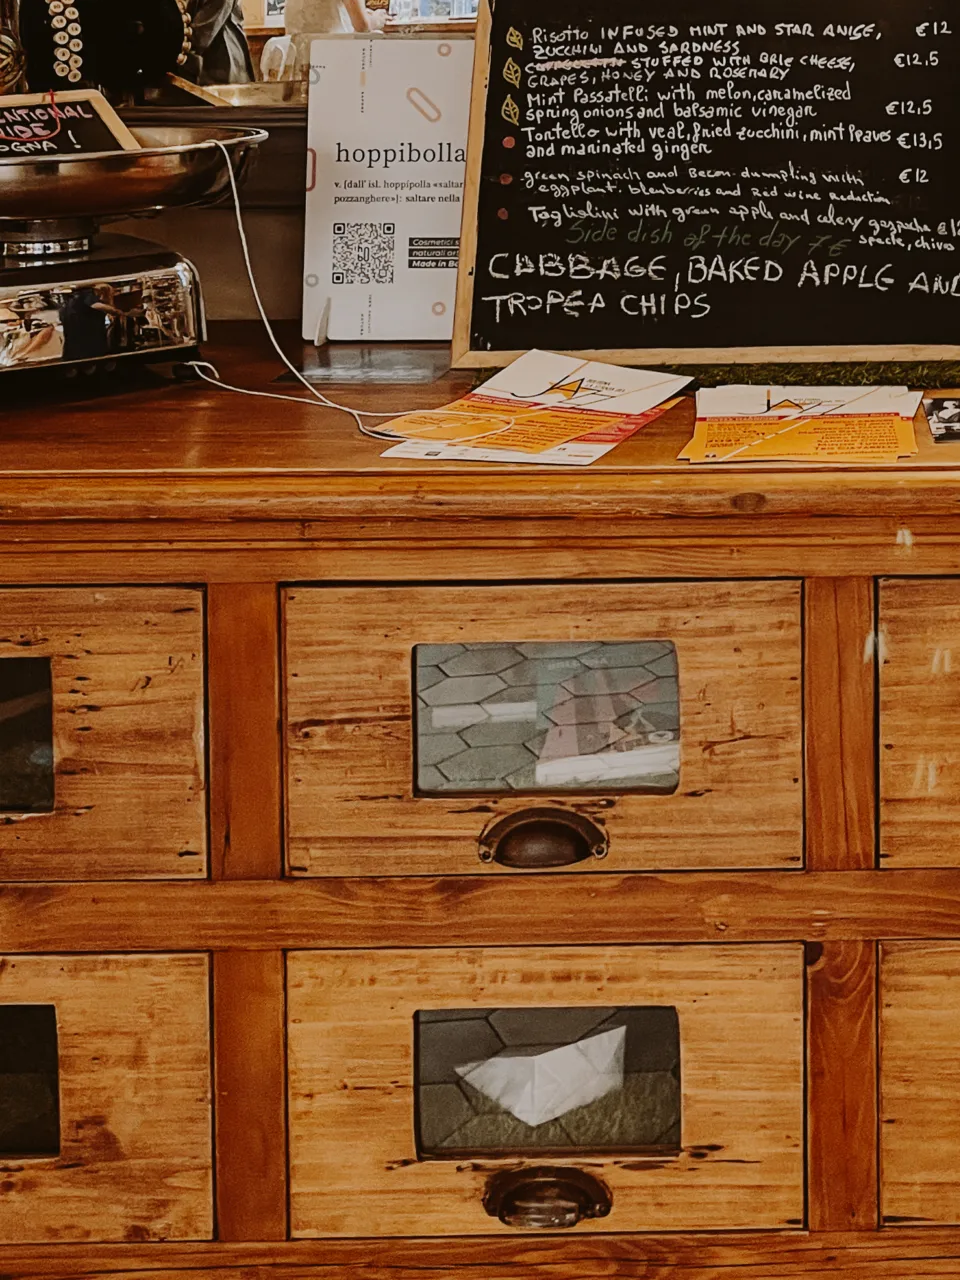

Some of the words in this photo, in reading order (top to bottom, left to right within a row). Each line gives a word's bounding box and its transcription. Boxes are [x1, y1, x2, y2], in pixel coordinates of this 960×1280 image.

[532, 25, 589, 43] Risotto
[689, 24, 728, 37] MINT
[735, 23, 767, 36] AND
[775, 23, 814, 37] STAR
[614, 42, 648, 54] AND
[631, 56, 703, 68] STUFFED
[713, 56, 751, 67] WITH
[601, 68, 656, 83] HONEY
[663, 67, 701, 79] AND
[527, 88, 565, 108] Mint
[657, 82, 695, 102] with
[0, 105, 93, 123] NTIONAL
[526, 106, 578, 125] spring
[636, 101, 664, 118] and
[674, 101, 742, 117] balsamic
[751, 102, 817, 127] vinegar
[605, 121, 640, 138] with
[336, 142, 466, 168] hoppibolla
[526, 143, 555, 158] and
[561, 138, 645, 155] marinated
[652, 141, 712, 161] ginger
[646, 166, 678, 178] and
[405, 194, 436, 202] saltare
[716, 184, 741, 197] and
[628, 204, 667, 218] with
[729, 201, 774, 222] apple
[780, 210, 810, 225] and
[566, 221, 618, 244] Side
[628, 219, 672, 244] dish
[684, 224, 711, 250] of
[712, 223, 751, 247] the
[760, 221, 801, 254] day
[688, 255, 783, 284] BAKED
[797, 260, 895, 291] APPLE
[620, 292, 711, 318] CHIPS
